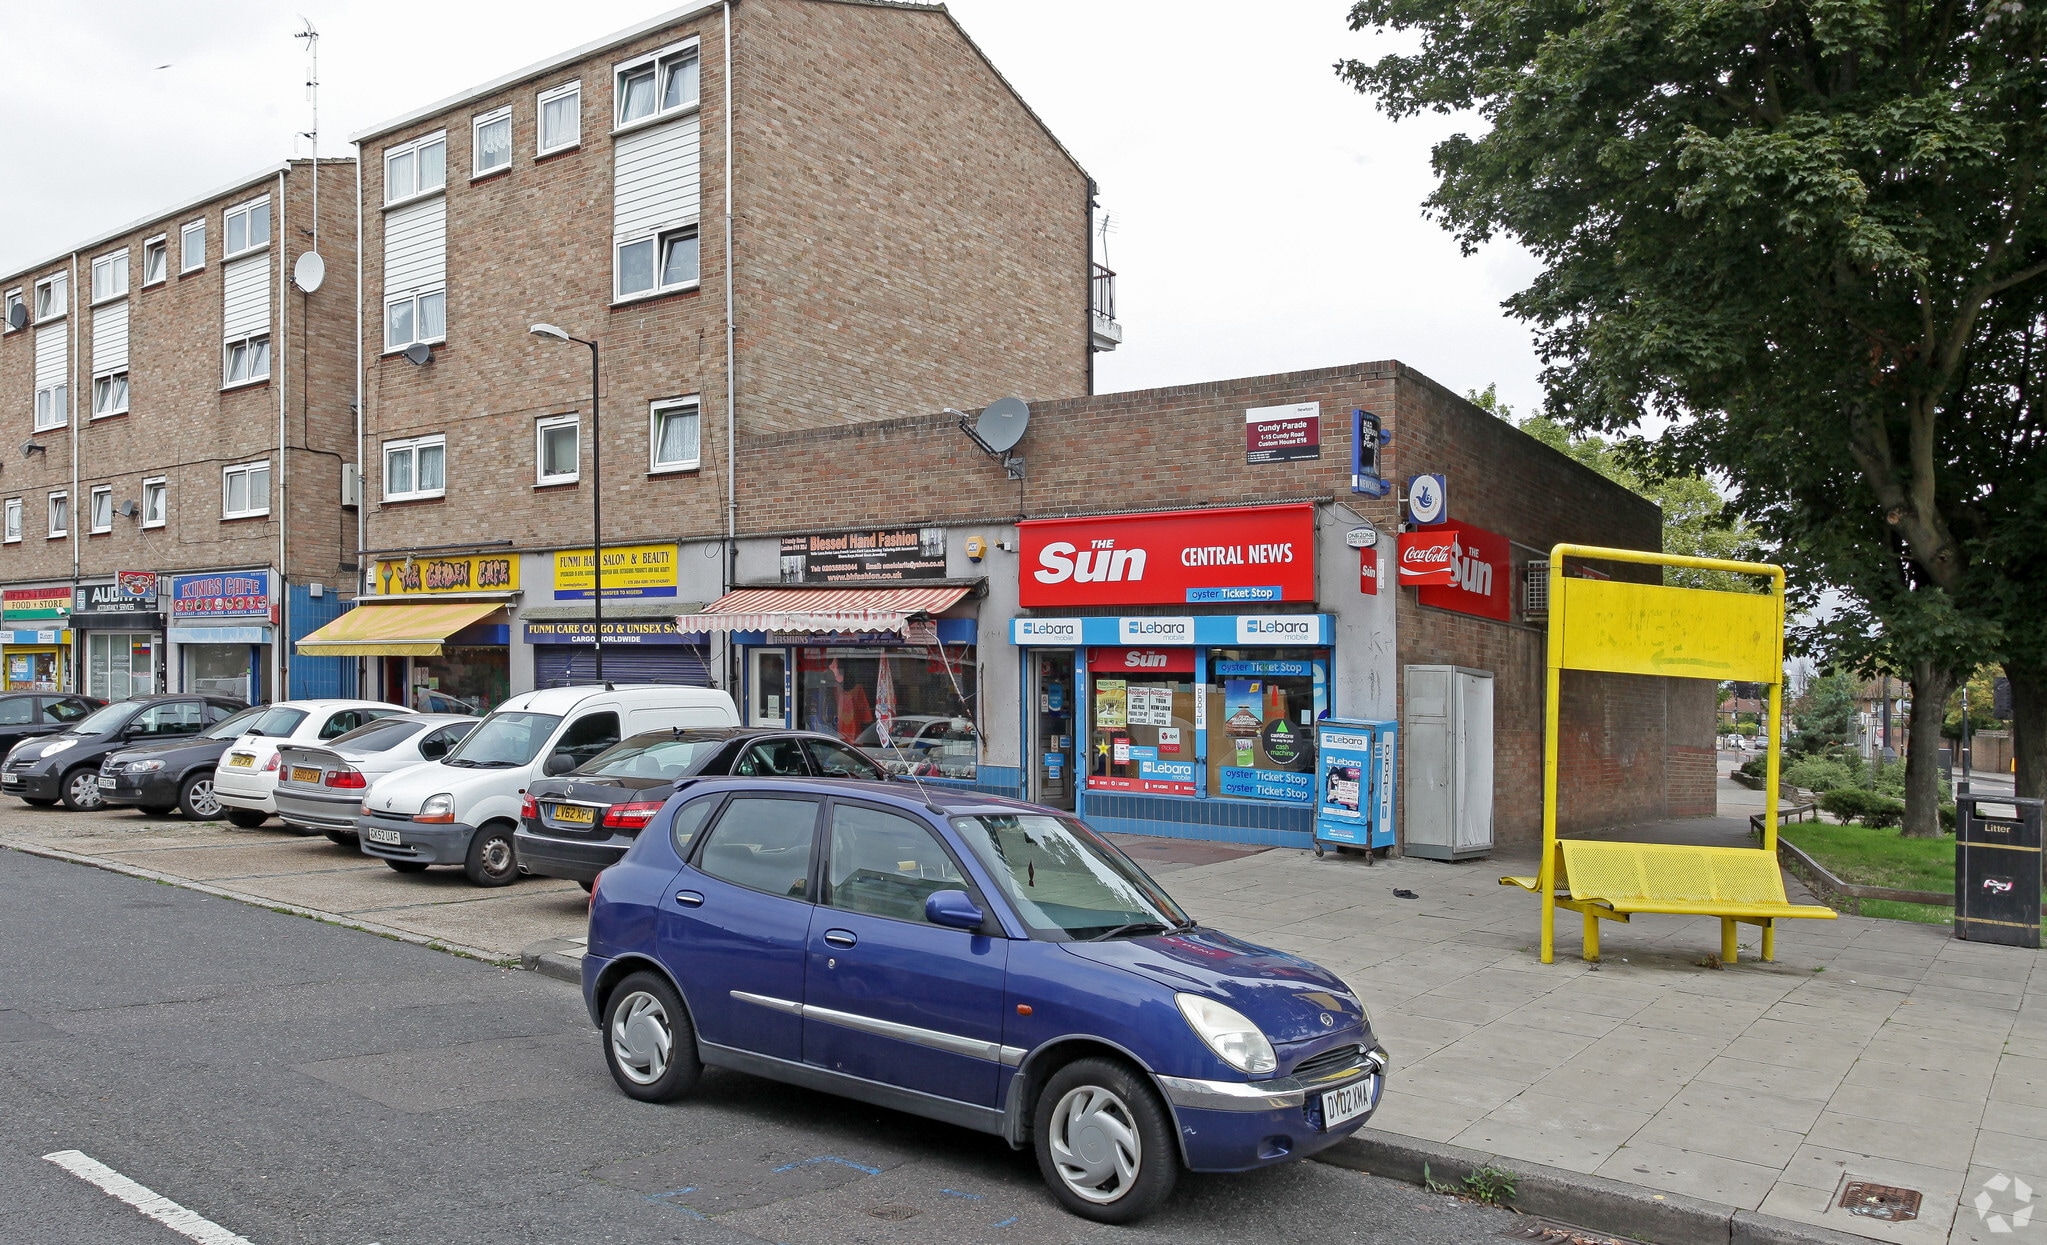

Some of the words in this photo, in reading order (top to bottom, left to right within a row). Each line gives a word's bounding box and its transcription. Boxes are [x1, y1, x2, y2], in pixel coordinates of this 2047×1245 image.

[1258, 424, 1280, 432] Cundy
[1282, 421, 1307, 430] Parade
[810, 534, 847, 551] Blessed
[850, 533, 876, 548] Hand
[878, 531, 918, 547] Fashion
[1090, 539, 1115, 549] THE
[1404, 546, 1451, 563] Coca-Cola
[1468, 546, 1480, 558] THE
[560, 556, 580, 568] FUNMI
[584, 555, 596, 566] HAI
[603, 554, 626, 566] SALON
[631, 553, 638, 564] &
[642, 551, 670, 564] BEAUTY
[1033, 541, 1148, 585] Sun
[1180, 546, 1244, 568] CENTRAL
[1248, 543, 1294, 564] NEWS
[426, 560, 471, 589] GARDEN
[478, 559, 510, 587] CAFE
[1362, 564, 1376, 578] Sun
[34, 588, 70, 598] TROPICAL
[182, 578, 222, 598] KINGS
[225, 577, 260, 596] CAFE
[1192, 588, 1219, 600] oyster
[1222, 588, 1250, 598] Ticket
[1252, 588, 1274, 600] Stop
[40, 600, 63, 608] STORE
[529, 624, 555, 634] FUNMI
[556, 624, 579, 634] CARE
[582, 624, 613, 634] CAGO
[616, 624, 624, 633] &
[627, 624, 661, 634] UNISEX
[1033, 622, 1074, 635] Lebara
[1140, 622, 1185, 634] Lebara
[1258, 620, 1308, 633] Lebara
[1124, 651, 1168, 668] Sun
[1221, 664, 1248, 673] oyster
[1251, 662, 1280, 672] Ticket
[1280, 662, 1303, 674] Stop
[1333, 736, 1363, 746] Lebara
[1152, 762, 1191, 775] Lebara
[1333, 756, 1362, 767] Lebara
[1226, 770, 1253, 780] oyster
[1256, 770, 1284, 782] Ticket
[1286, 774, 1308, 786] Stop
[1382, 744, 1390, 804] Lebara
[1226, 784, 1254, 794] oyster
[1256, 785, 1284, 797] Ticket
[1286, 788, 1308, 800] Stop
[1984, 823, 2010, 834] Litter
[1328, 1090, 1352, 1120] DY02
[1353, 1083, 1368, 1110] XMA
